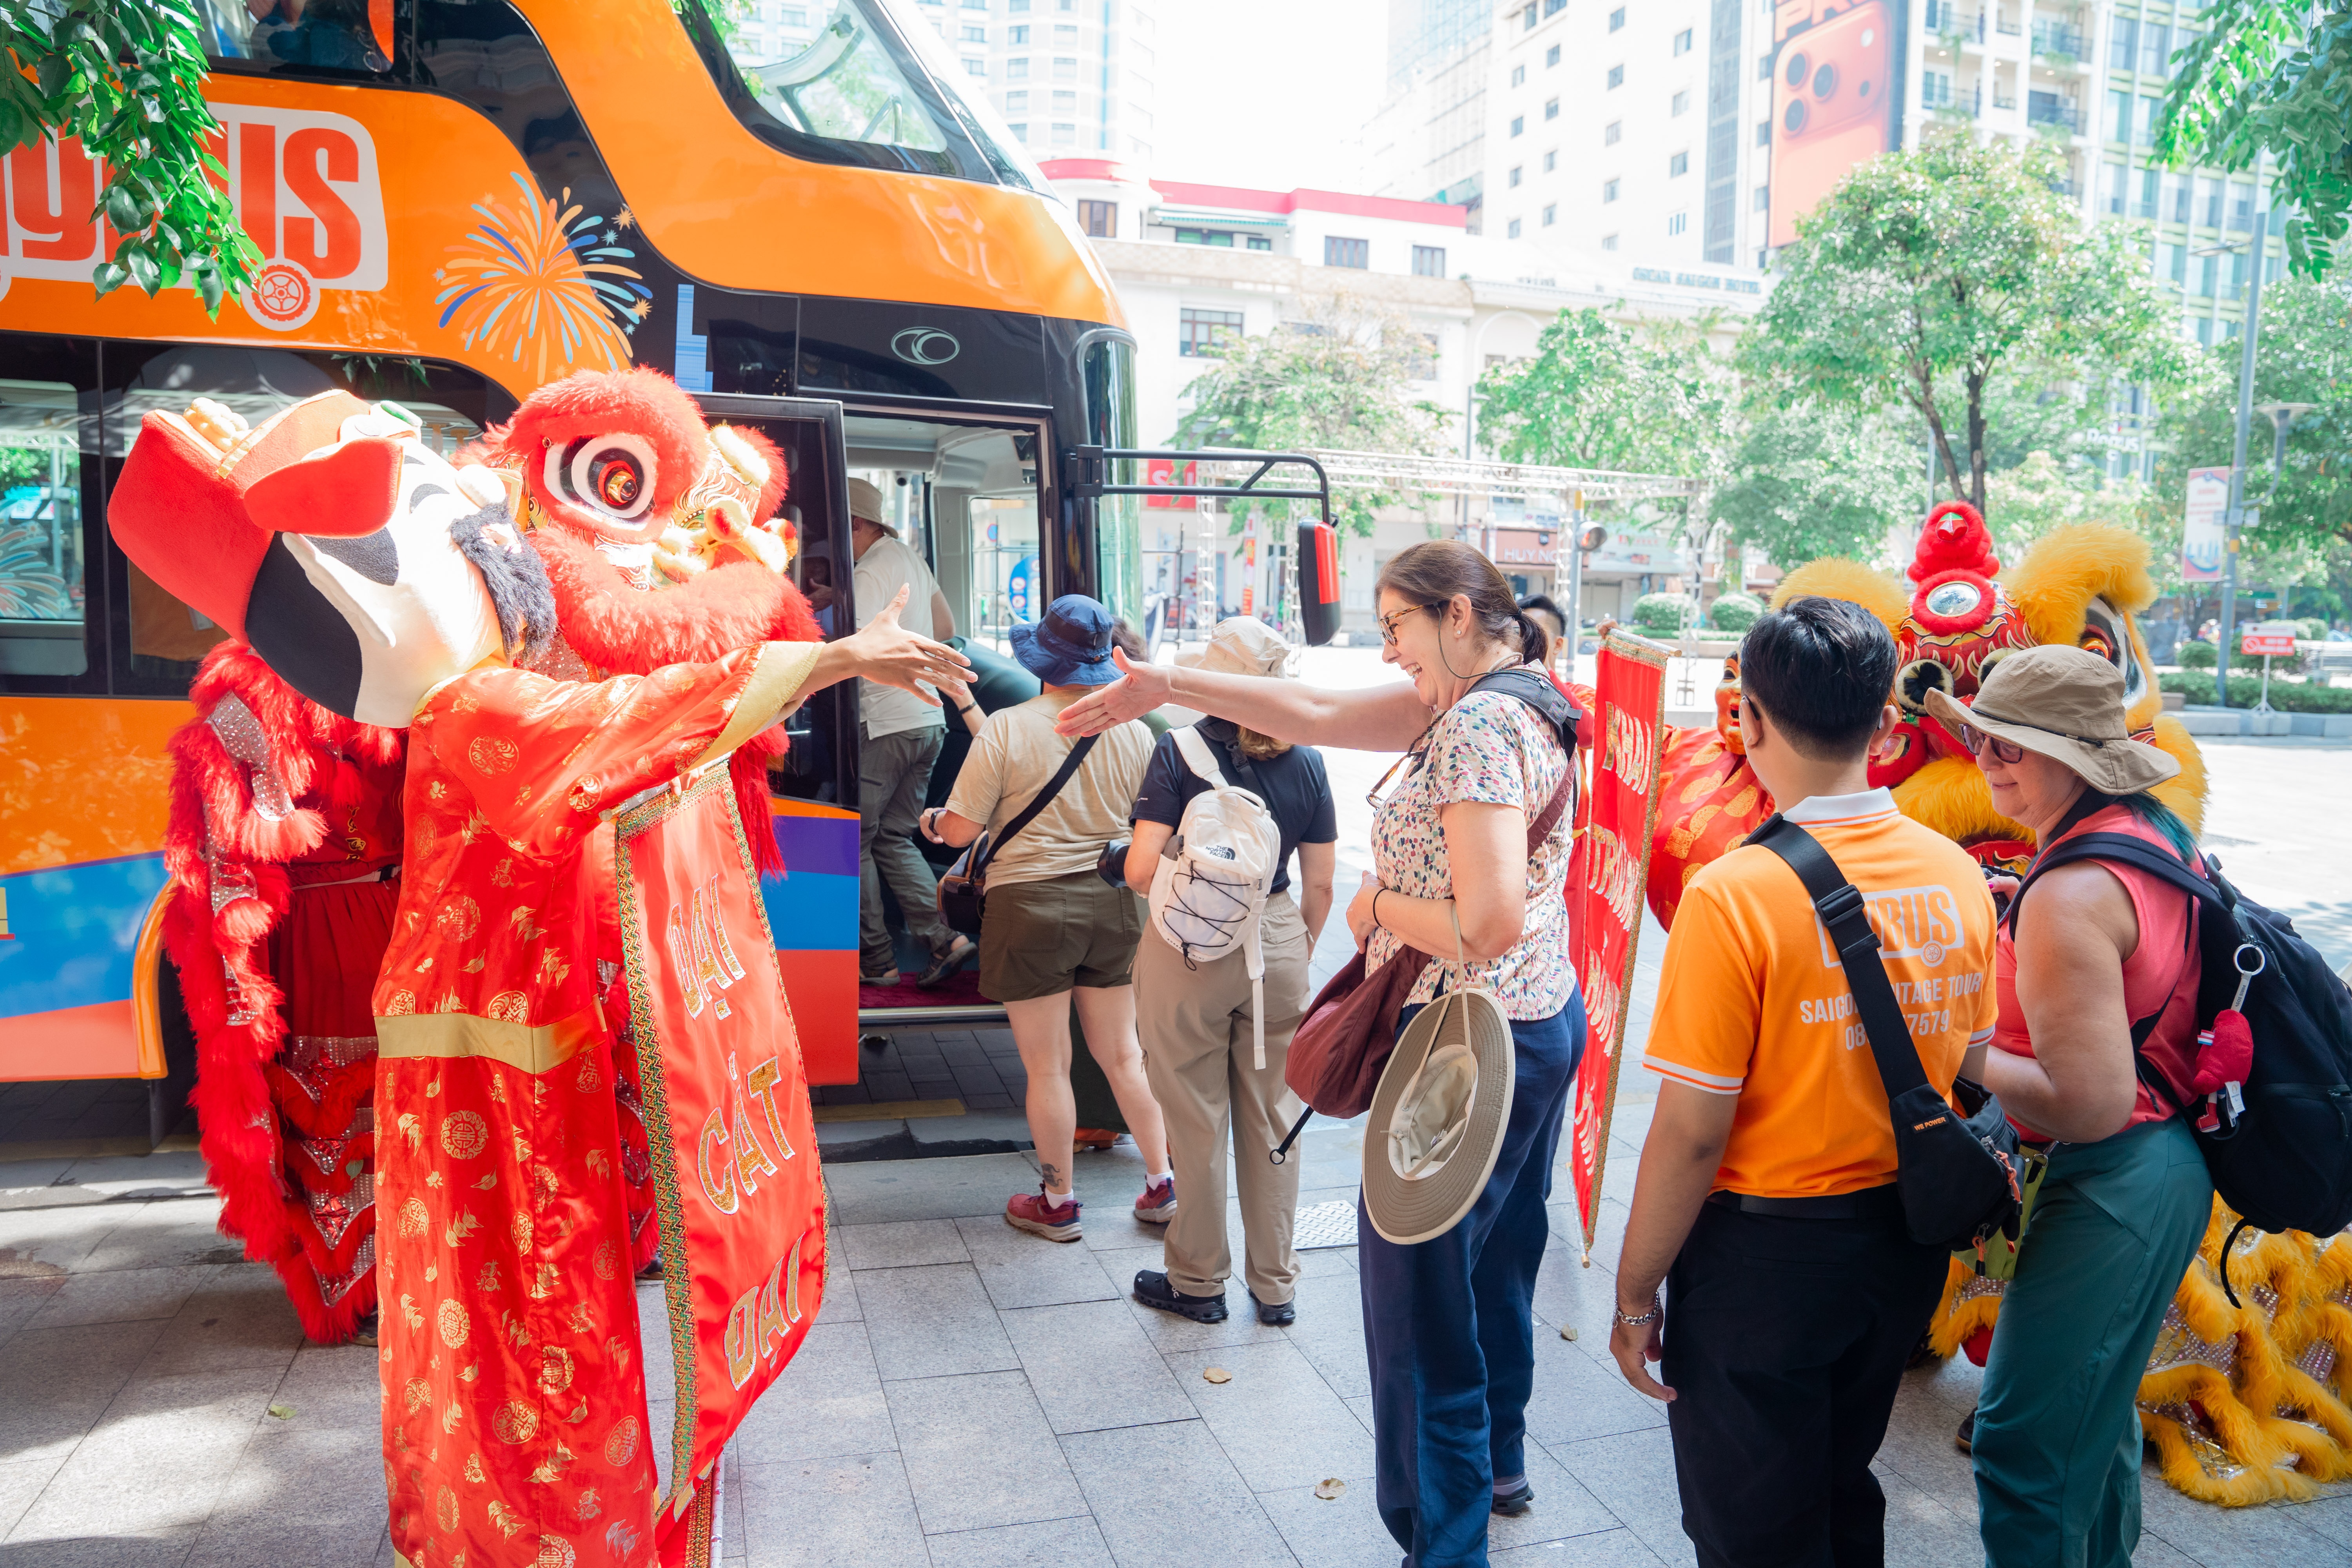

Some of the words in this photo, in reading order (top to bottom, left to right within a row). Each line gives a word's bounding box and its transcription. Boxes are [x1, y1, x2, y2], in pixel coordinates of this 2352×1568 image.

[1675, 272, 1720, 290] SAIGON
[1725, 278, 1761, 294] HOTEL
[1504, 548, 1536, 563] HUY
[1205, 846, 1226, 855] NORTH
[1890, 978, 1942, 1004] ITAGE
[1947, 972, 1982, 998] TOUR
[1924, 1117, 1946, 1128] POWER
[697, 1049, 795, 1215] CÁT
